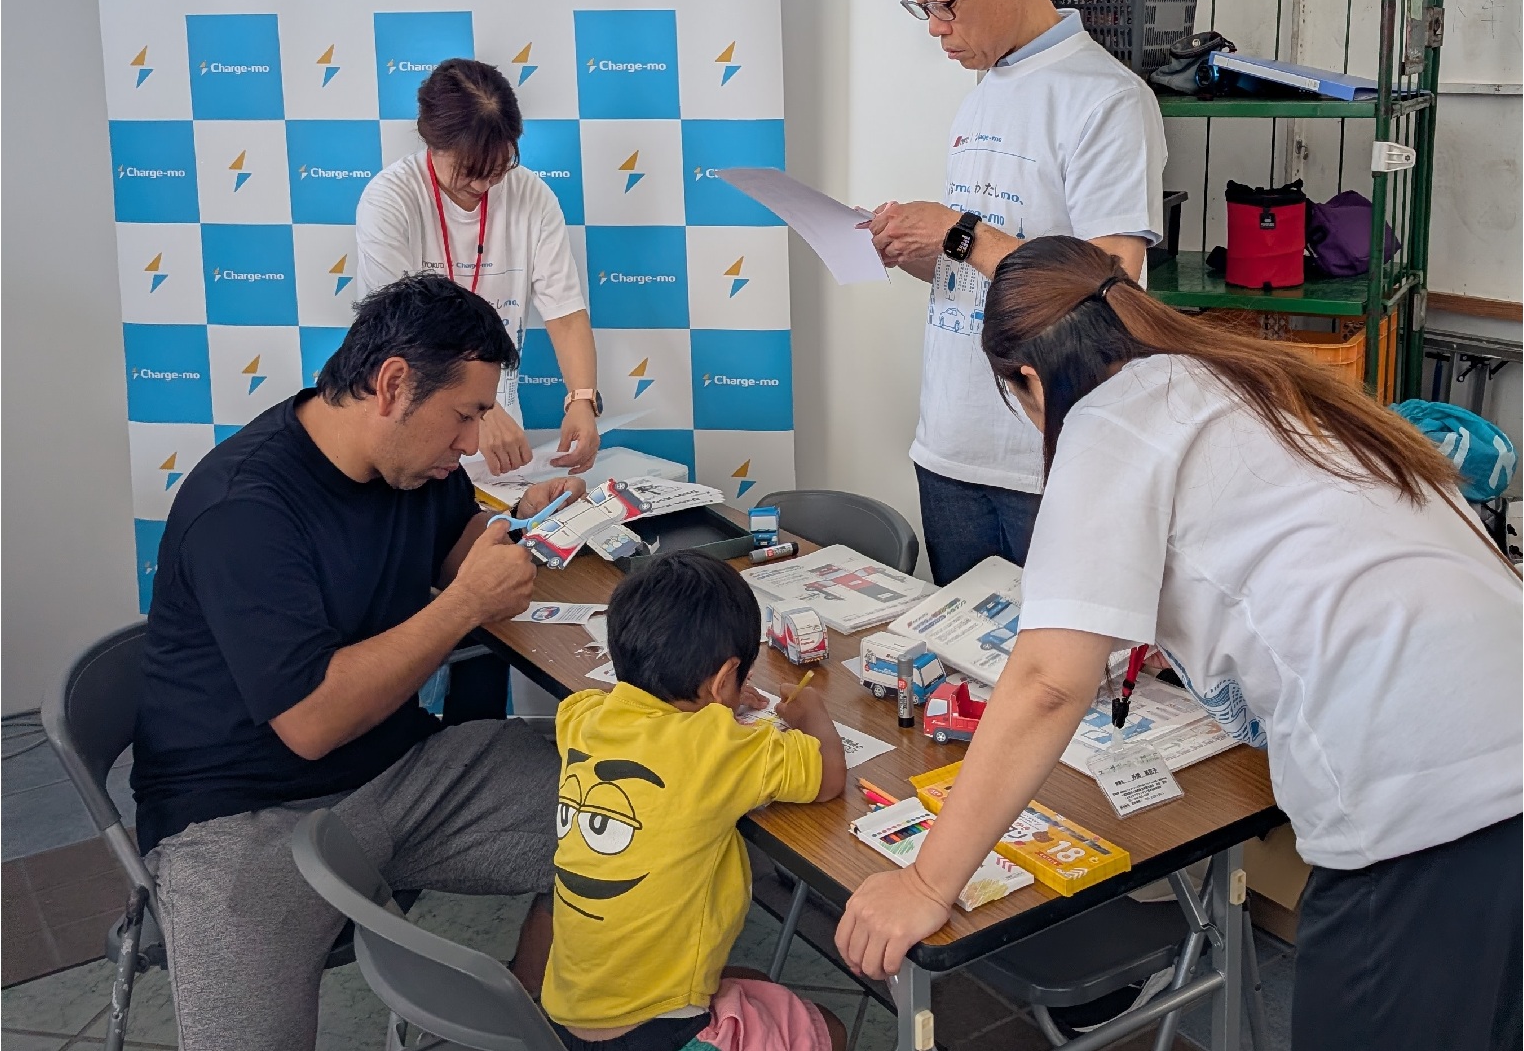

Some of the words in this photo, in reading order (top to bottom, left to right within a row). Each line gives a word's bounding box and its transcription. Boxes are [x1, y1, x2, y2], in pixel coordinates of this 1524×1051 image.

[210, 63, 270, 75] Charge-mo
[599, 60, 667, 72] Charge-mo
[126, 167, 186, 179] Charge-mo
[310, 168, 372, 180] Charge-mo
[223, 270, 285, 281] Charge-mo
[610, 273, 676, 284] Charge-mo
[140, 368, 201, 380] Charge-mo
[518, 374, 565, 386] Charge-
[714, 375, 779, 387] Charge-mo
[1046, 840, 1086, 862] 18
